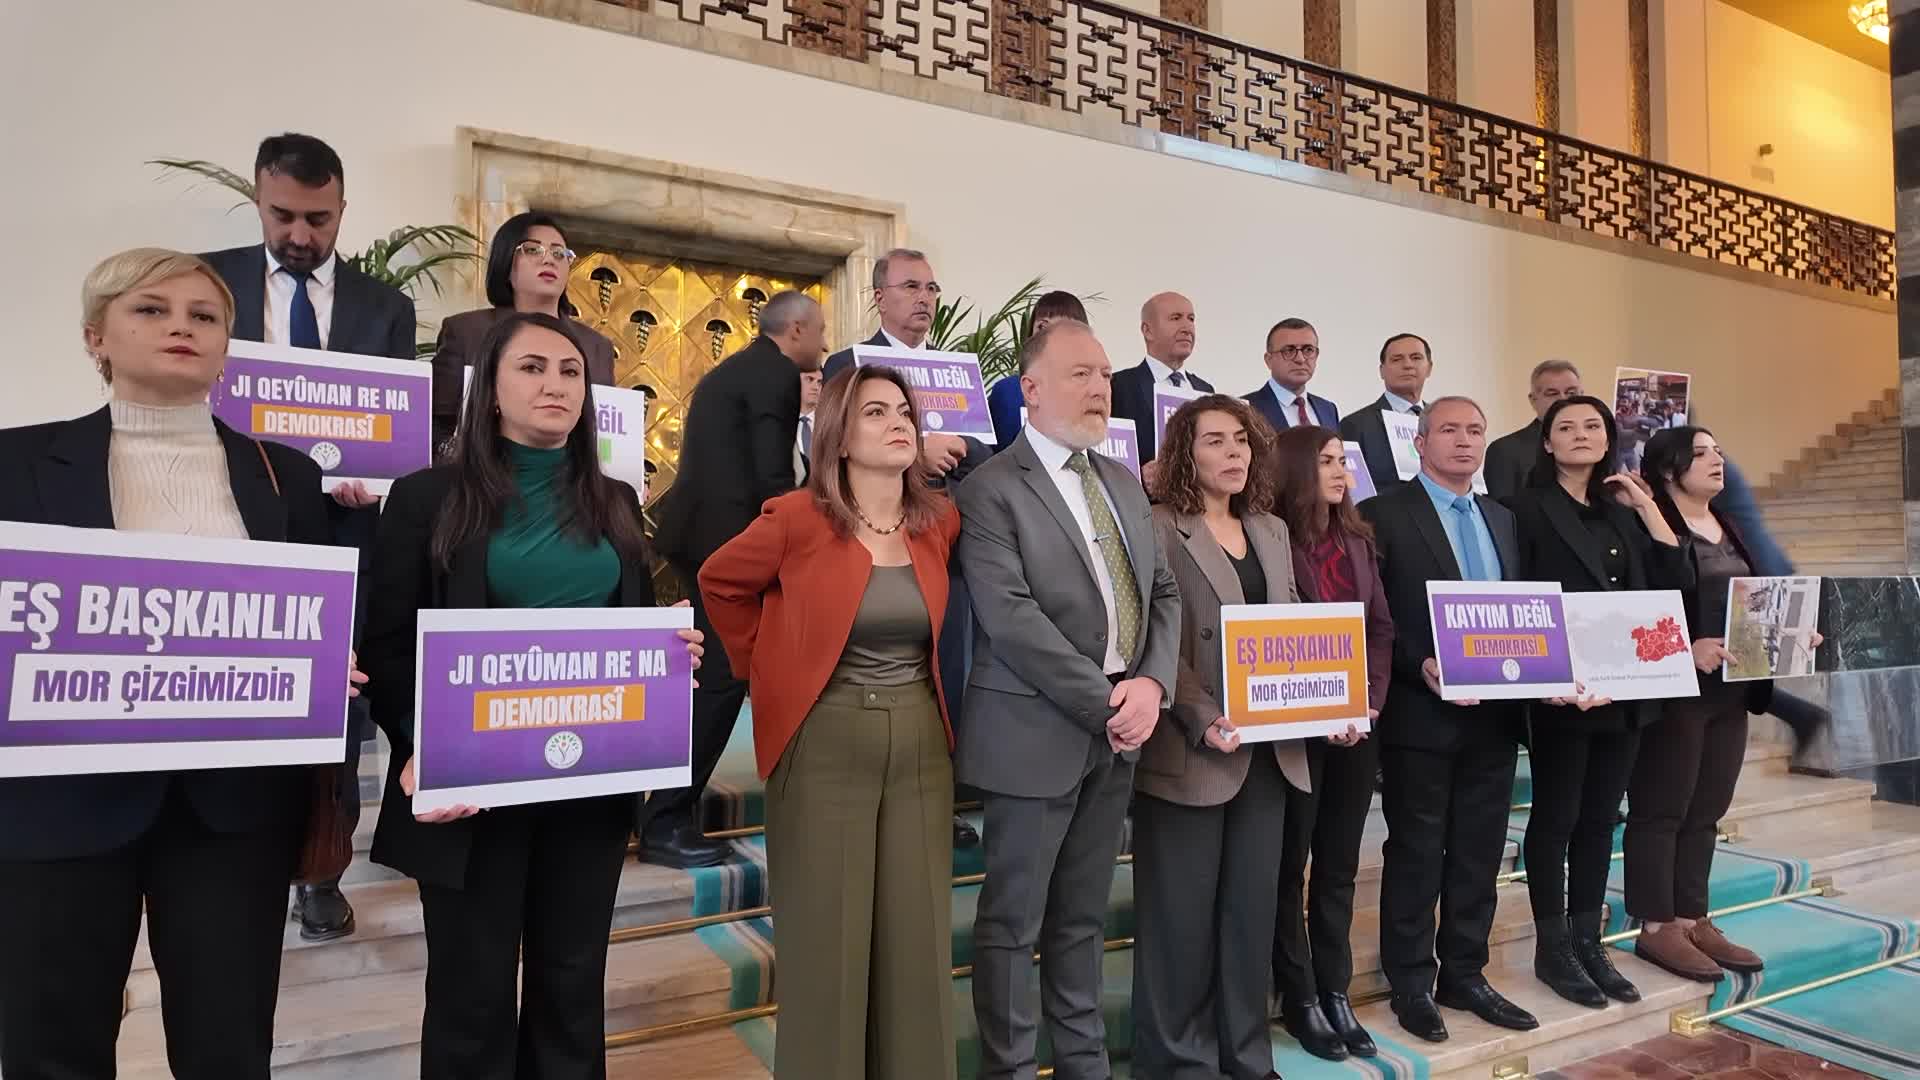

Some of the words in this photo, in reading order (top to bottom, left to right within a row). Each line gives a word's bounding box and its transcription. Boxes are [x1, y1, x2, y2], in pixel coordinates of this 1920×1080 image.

[231, 375, 251, 398] JI
[257, 375, 352, 407] QEYÛMAN
[358, 386, 380, 409] RE
[385, 389, 410, 412] NA
[932, 365, 975, 390] DEĞİL
[264, 411, 376, 440] DEMOKRASÎ
[598, 403, 627, 435] ĞİL
[0, 580, 62, 651] EŞ
[77, 584, 324, 653] BAŞKANLIK
[1444, 603, 1509, 629] KAYYIM
[1512, 598, 1556, 629] DEĞİL
[448, 654, 474, 685] JI
[481, 645, 598, 685] QEYÛMAN
[604, 650, 632, 678] RE
[638, 649, 667, 678] NA
[1236, 636, 1258, 674] EŞ
[1263, 632, 1353, 672] BAŞKANLIK
[32, 669, 111, 703] MOR
[121, 664, 296, 712] ÇİZGİMİZDİR
[1251, 683, 1278, 703] MOR
[1280, 676, 1345, 706] ÇİZGİMİZDİR
[488, 685, 626, 729] DEMOKRASÎ
